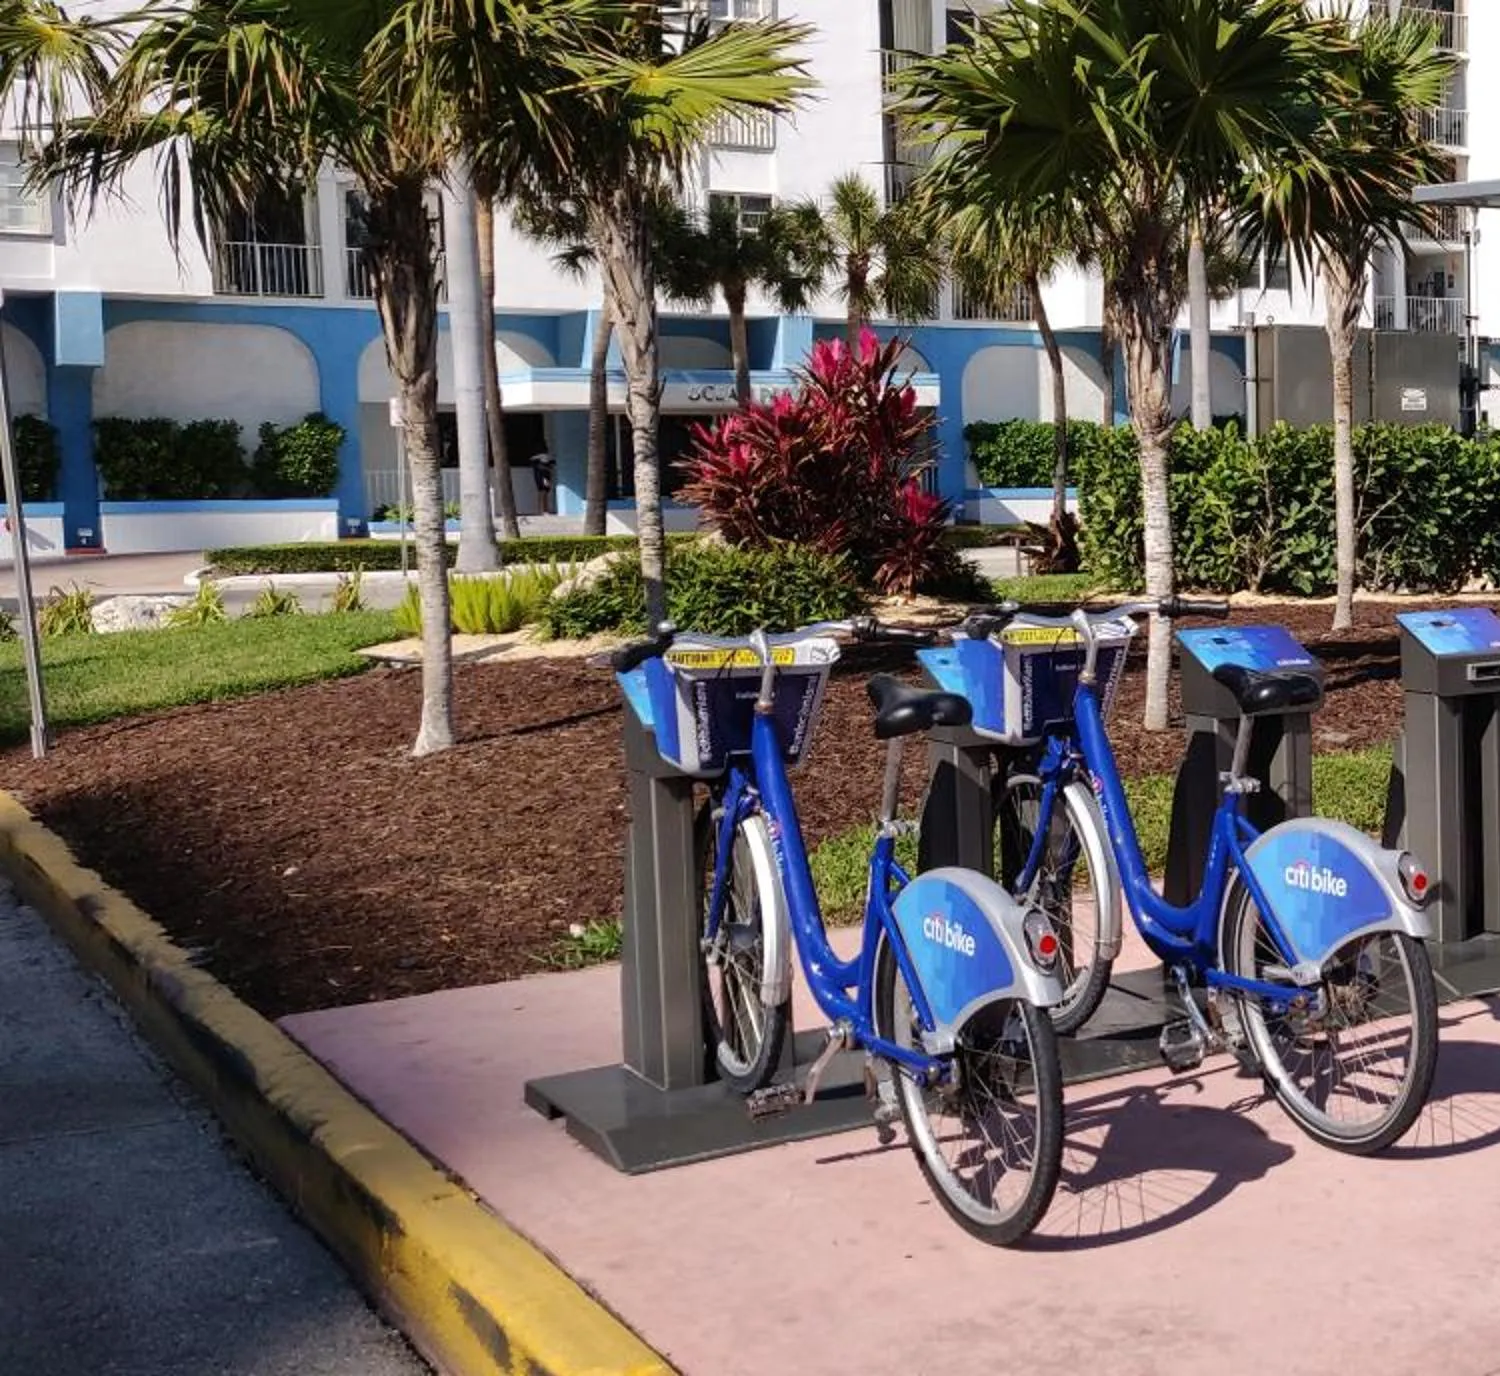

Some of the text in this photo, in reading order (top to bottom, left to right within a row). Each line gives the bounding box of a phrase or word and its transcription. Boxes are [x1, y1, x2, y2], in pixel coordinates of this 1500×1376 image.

[1284, 864, 1348, 897] citi bike
[923, 916, 976, 957] citi bike
